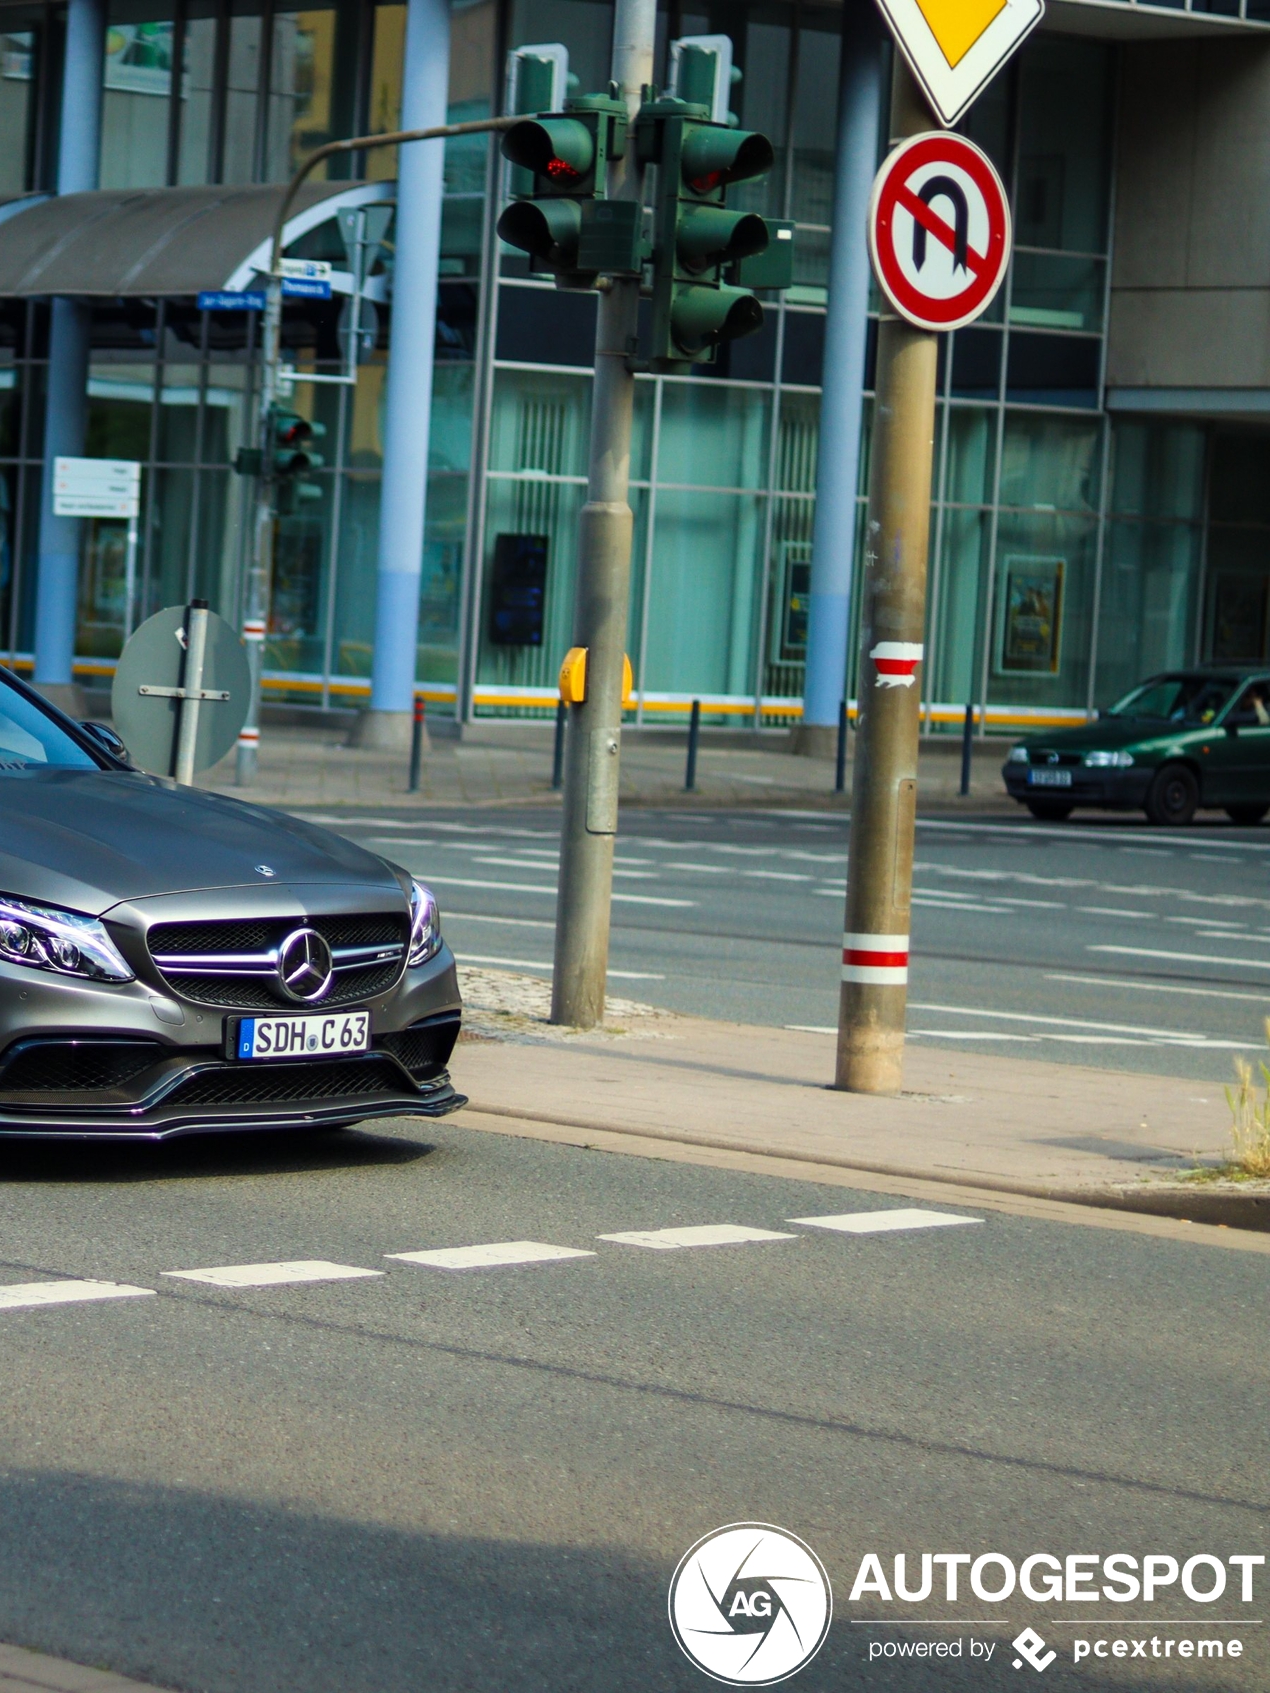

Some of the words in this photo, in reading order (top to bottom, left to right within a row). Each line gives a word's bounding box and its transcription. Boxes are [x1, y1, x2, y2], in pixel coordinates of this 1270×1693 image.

[256, 1021, 306, 1053] SDH
[321, 1019, 335, 1049] C
[340, 1017, 367, 1048] 63
[243, 1042, 250, 1052] D
